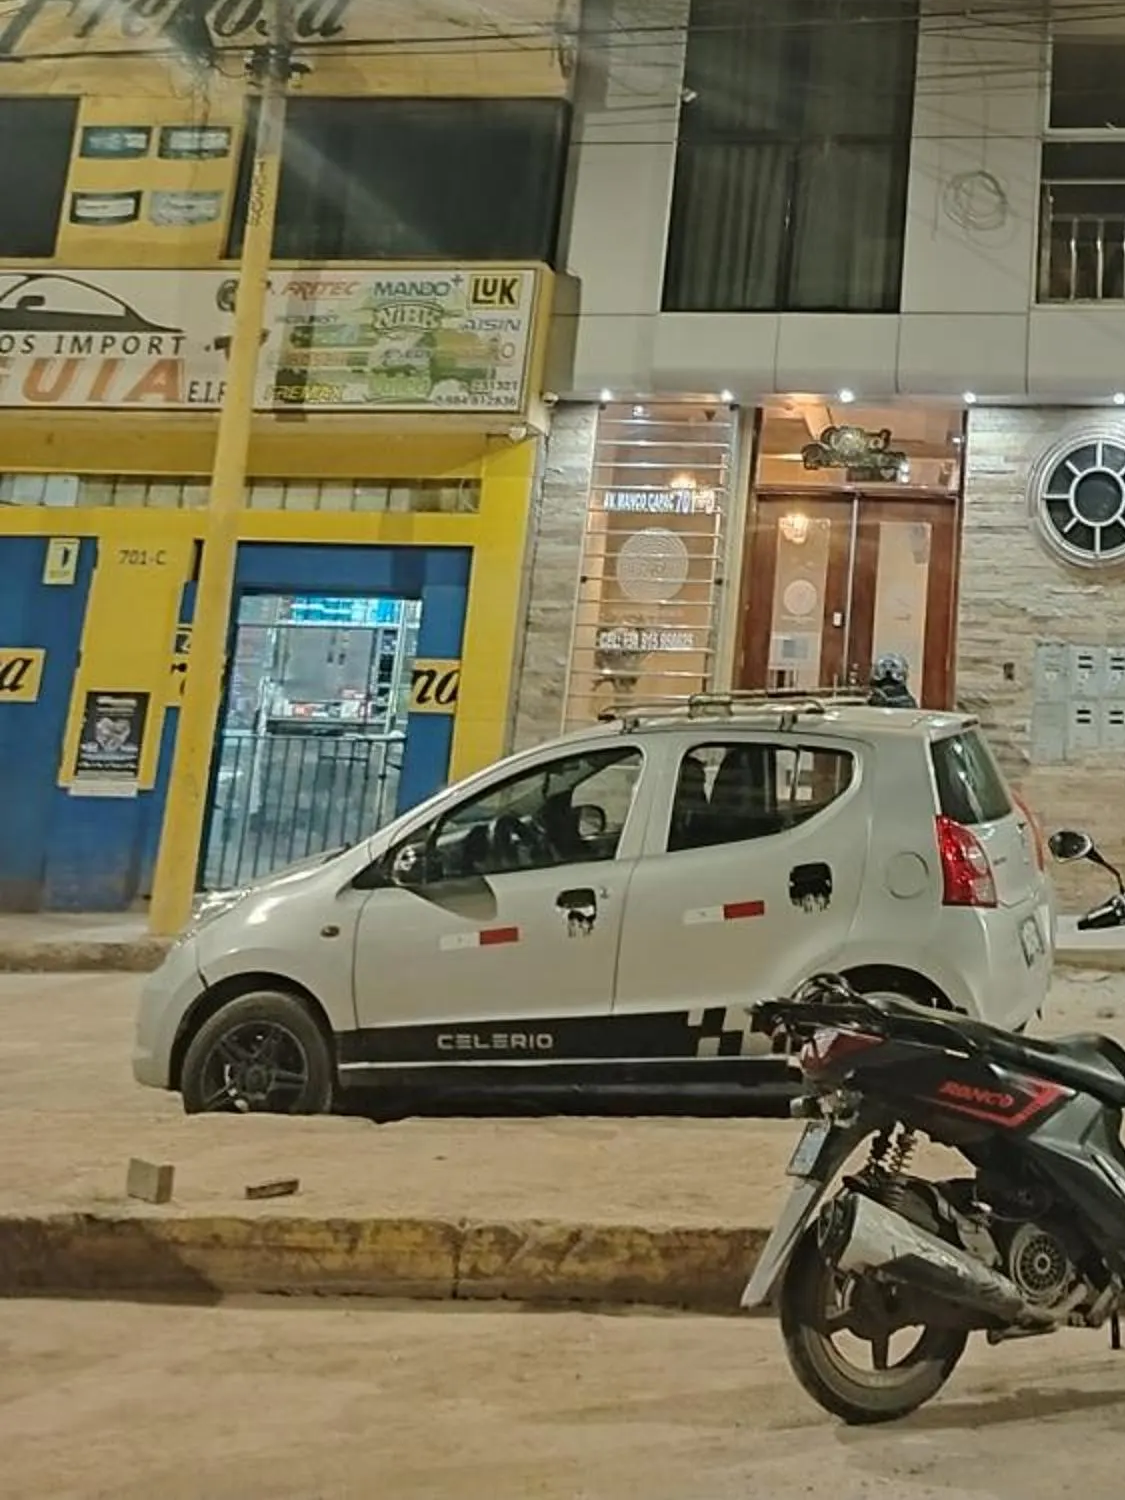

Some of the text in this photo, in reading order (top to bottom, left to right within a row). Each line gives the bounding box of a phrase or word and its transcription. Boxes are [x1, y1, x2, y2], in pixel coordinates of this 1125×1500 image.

[54, 334, 187, 356] IMPORT
[118, 549, 166, 566] 701-C
[437, 1033, 553, 1050] CELERIO
